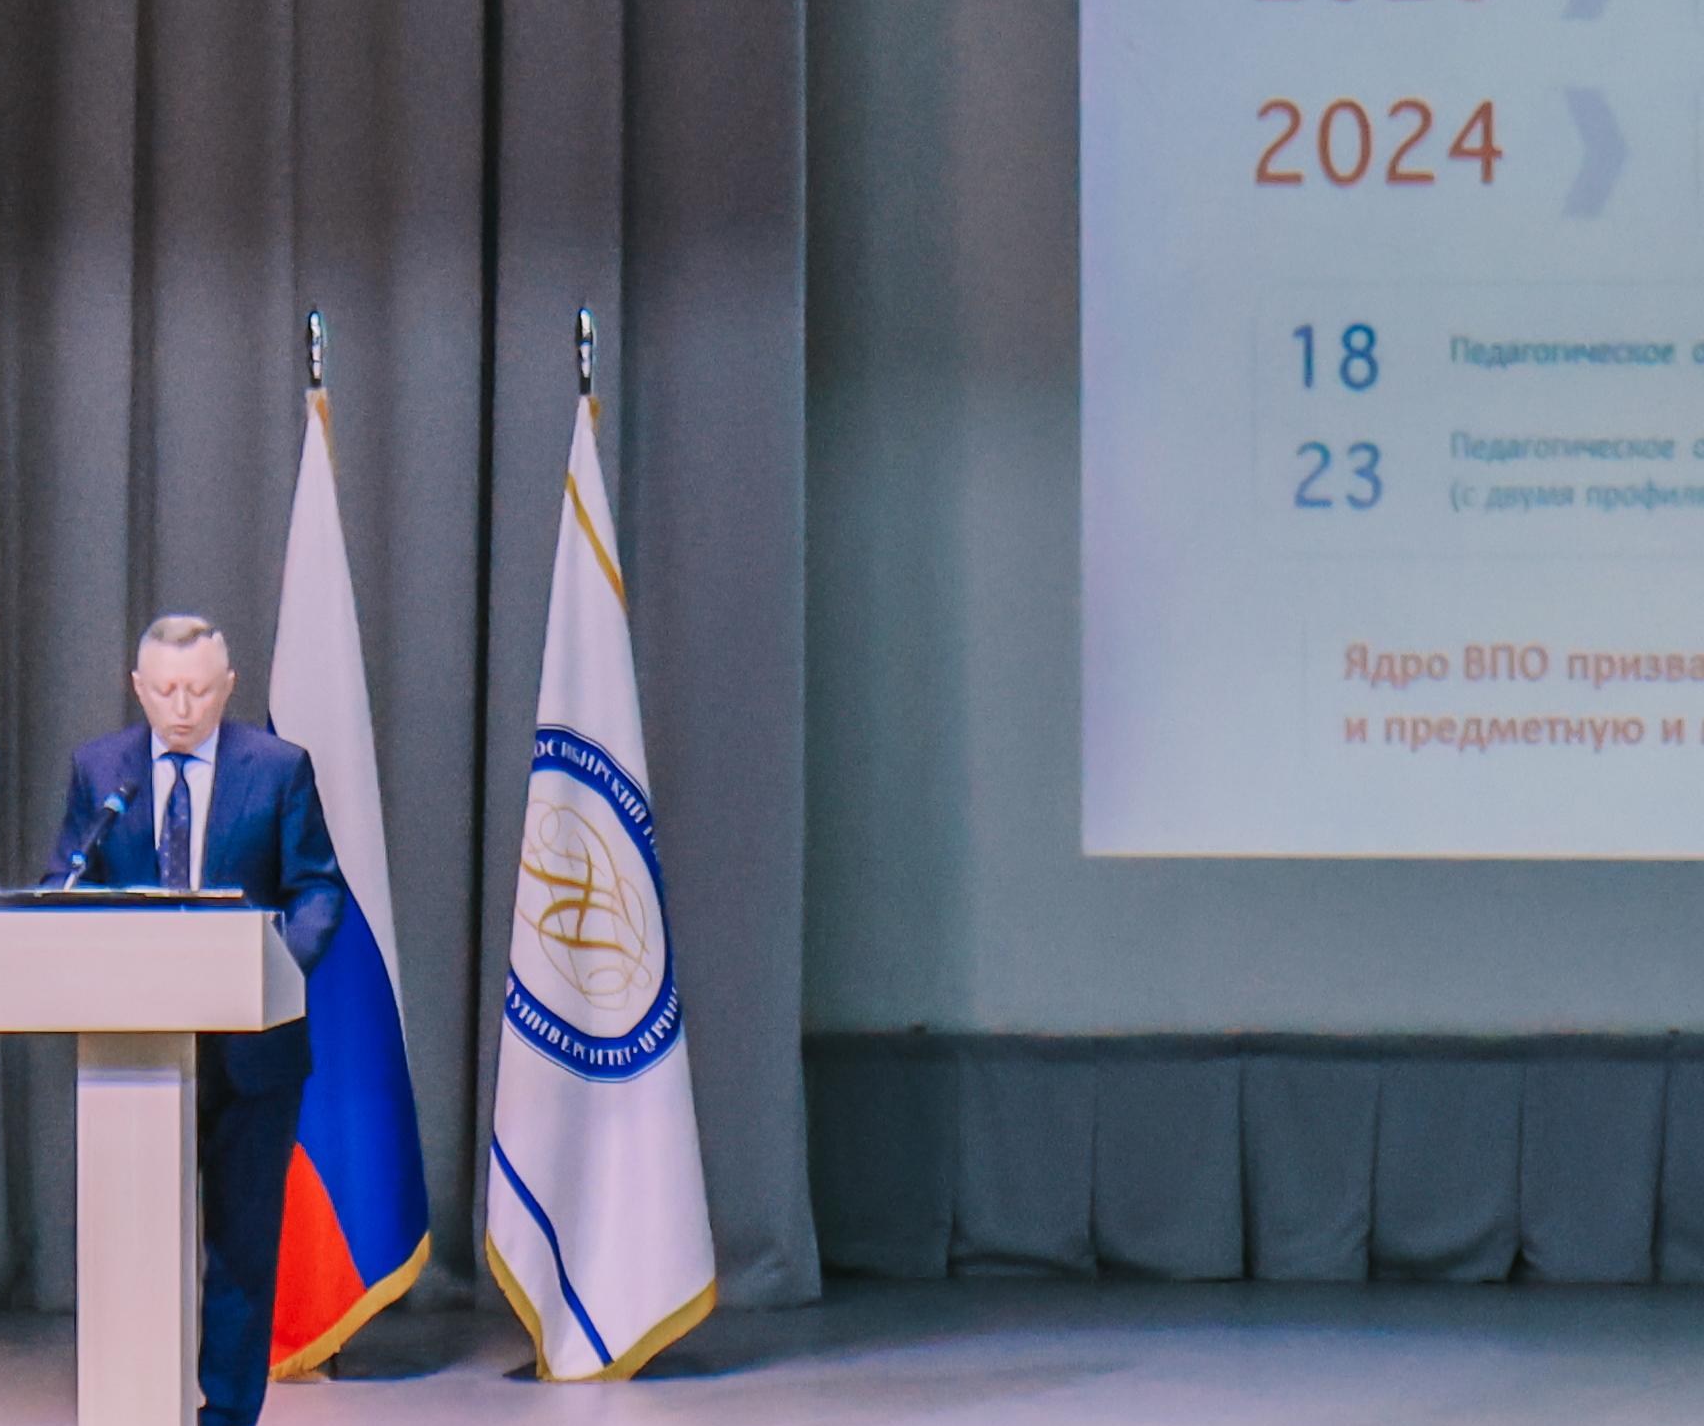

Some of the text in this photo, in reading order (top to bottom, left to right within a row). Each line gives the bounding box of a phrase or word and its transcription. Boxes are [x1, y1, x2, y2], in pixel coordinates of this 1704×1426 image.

[1255, 97, 1503, 187] 2024
[1293, 322, 1380, 393] 18
[1450, 336, 1677, 370] Педагогическое
[1294, 440, 1384, 511] 23
[1450, 430, 1676, 464] Педагогическое
[1344, 640, 1451, 690] Ядро
[1462, 641, 1550, 682] ВПО
[1343, 716, 1369, 743] и
[1384, 714, 1646, 753] предметную
[1660, 716, 1686, 744] и
